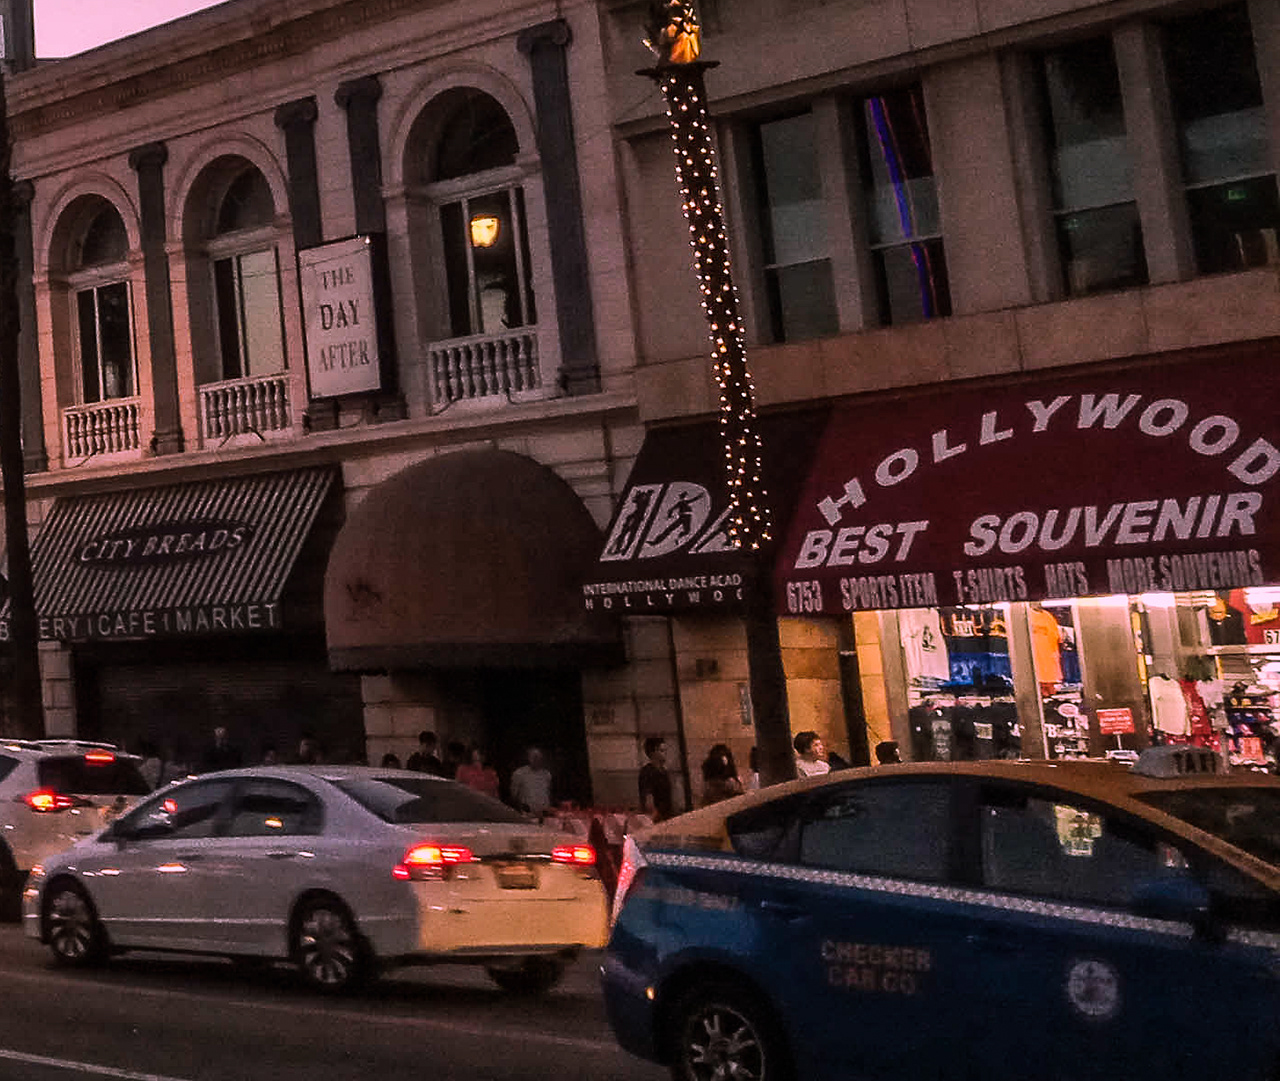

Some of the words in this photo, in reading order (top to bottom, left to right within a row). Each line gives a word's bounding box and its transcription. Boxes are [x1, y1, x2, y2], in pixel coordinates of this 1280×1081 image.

[321, 266, 356, 290] THE
[320, 299, 360, 330] DAY
[319, 339, 370, 371] AFTER
[816, 393, 1280, 526] HOLLYWOOD
[81, 537, 137, 561] CITY
[142, 526, 246, 556] BREADS
[794, 520, 930, 570] BEST
[963, 491, 1263, 557] SOUVENIR
[582, 580, 667, 596] INTERNATIONAL
[669, 576, 708, 590] DANCE
[786, 580, 823, 614] 6753
[840, 575, 898, 611] SPORTS
[899, 572, 938, 606] ITEM
[952, 565, 1028, 603] T-SHIRTS
[1044, 562, 1090, 599] HATS
[1106, 556, 1158, 594] MORE
[1159, 548, 1264, 592] SOUVENIRS
[98, 612, 157, 636] CAFE
[175, 604, 277, 631] MARKET
